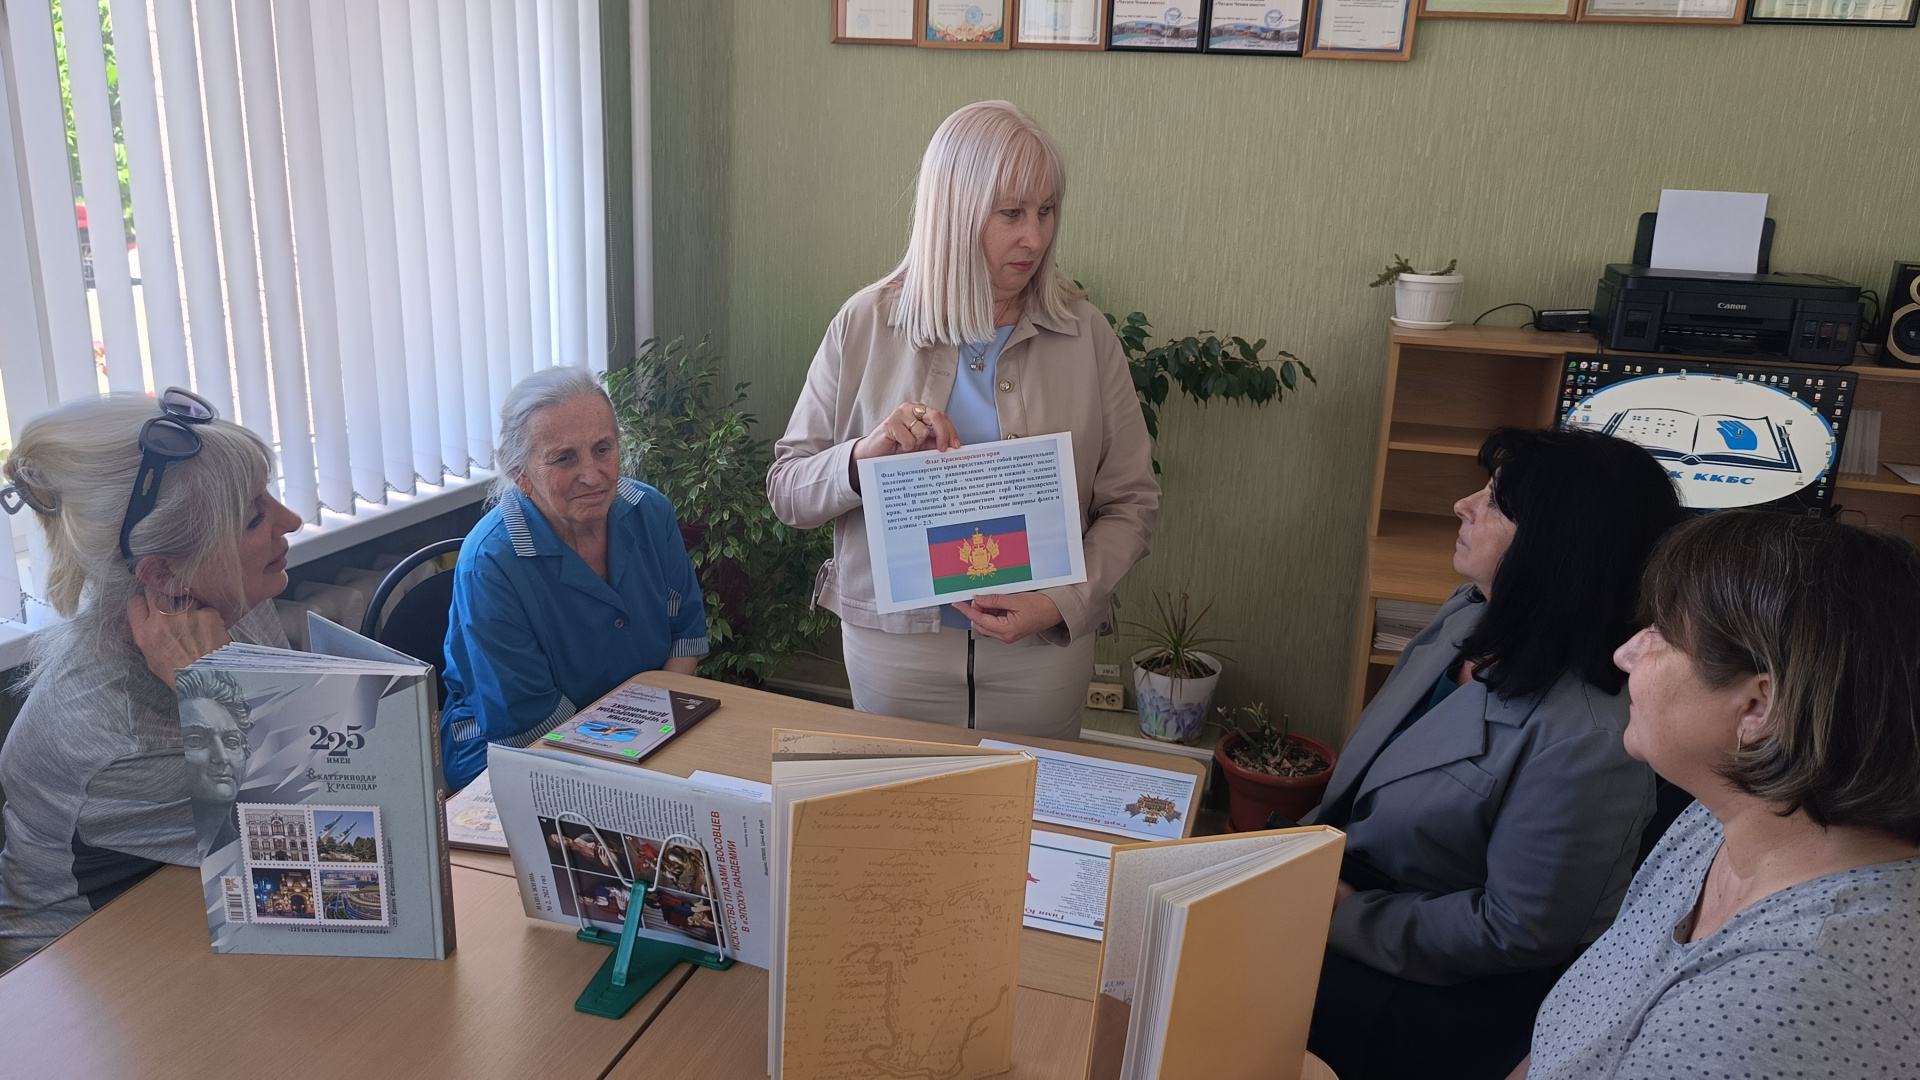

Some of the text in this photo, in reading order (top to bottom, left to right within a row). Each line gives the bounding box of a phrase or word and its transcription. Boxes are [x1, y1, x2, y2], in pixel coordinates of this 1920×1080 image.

[1717, 302, 1747, 310] Canon
[1693, 473, 1755, 484] ККБС
[597, 706, 659, 723] ЧЕРНОМОРСКОМ
[607, 714, 644, 724] ИСТОРИИ
[309, 725, 365, 756] 225
[1034, 808, 1101, 823] Краснодарско
[727, 840, 741, 888] ПАНДЕМИИ
[711, 811, 740, 950] ИСКУССТВО ГЛАЗАМИ ВОСОВЦЕВ
[542, 886, 550, 899] 2021
[736, 890, 749, 924] «ЭПОХУ»
